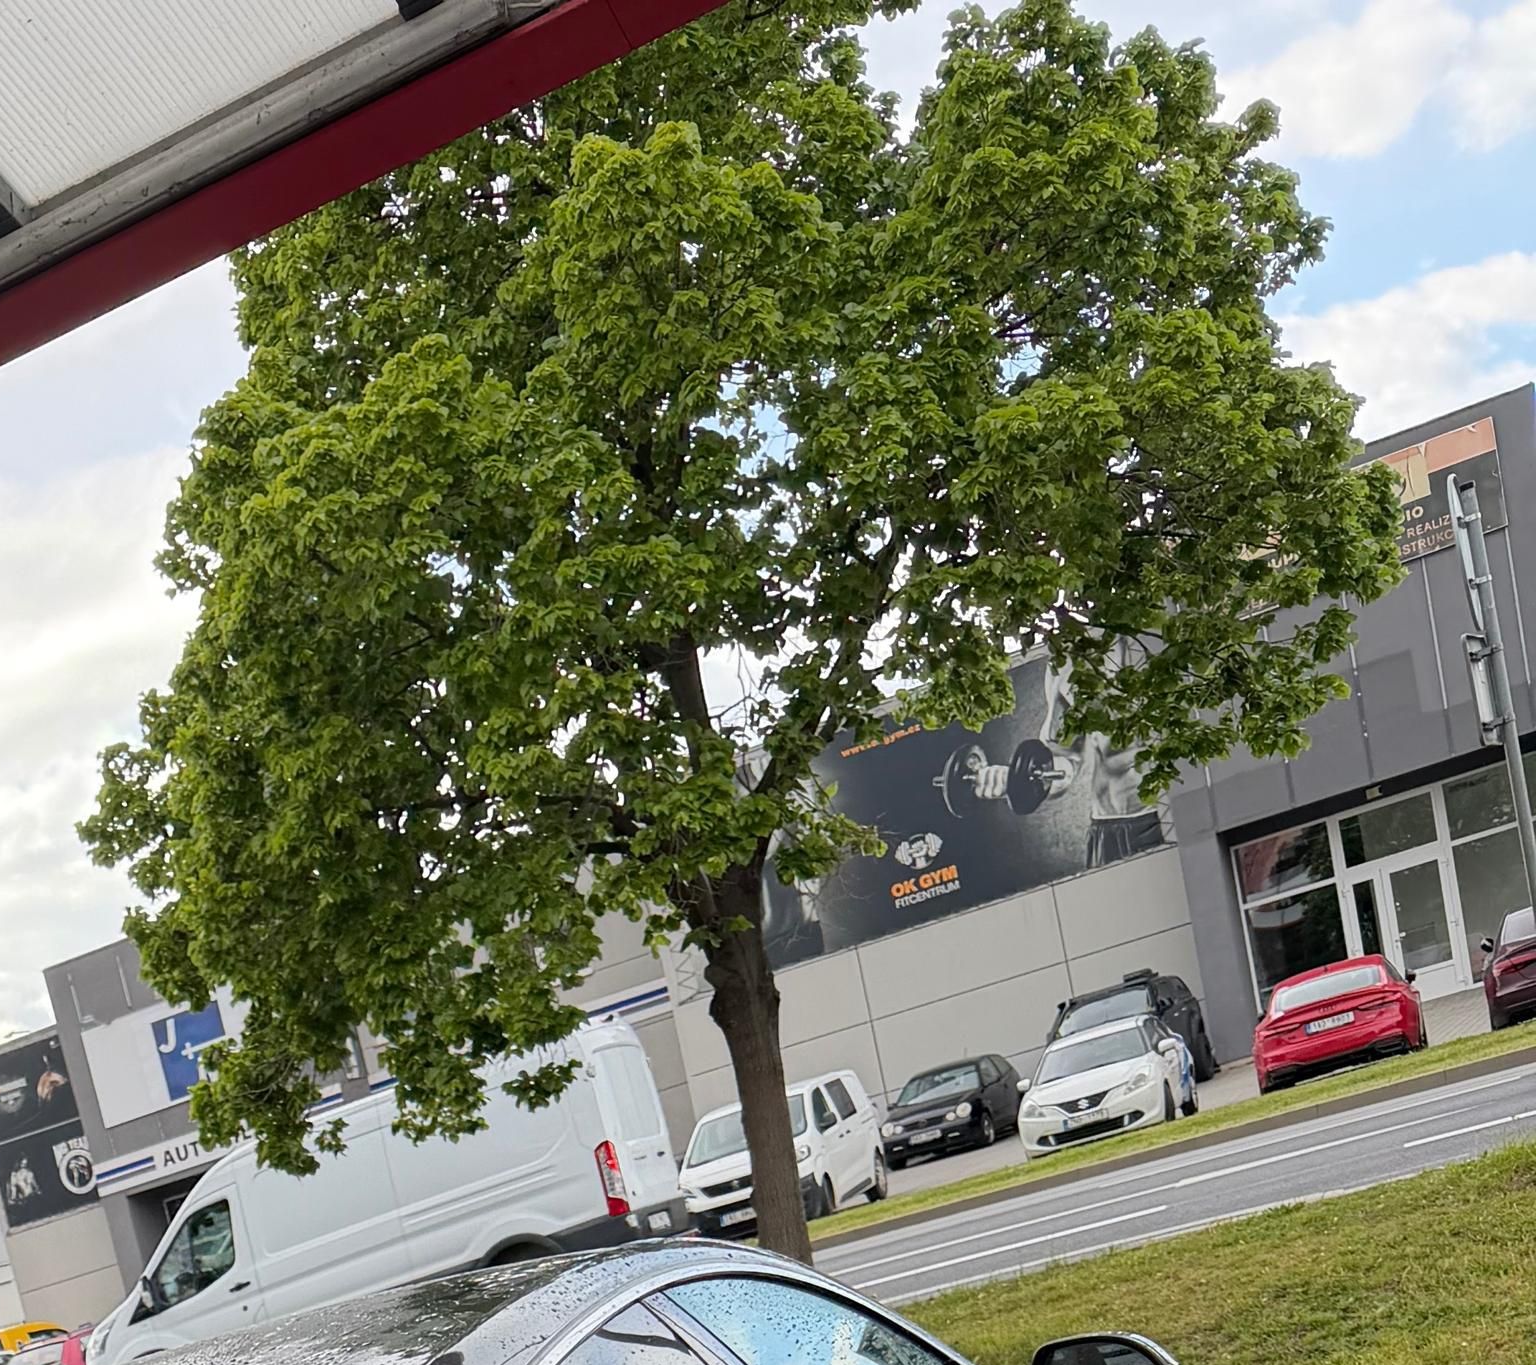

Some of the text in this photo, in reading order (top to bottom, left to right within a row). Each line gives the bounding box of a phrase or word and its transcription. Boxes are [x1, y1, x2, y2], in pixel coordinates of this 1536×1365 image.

[1406, 514, 1452, 539] REALIZ
[890, 865, 959, 898] OK GYM
[895, 879, 961, 909] FITCENTRUM
